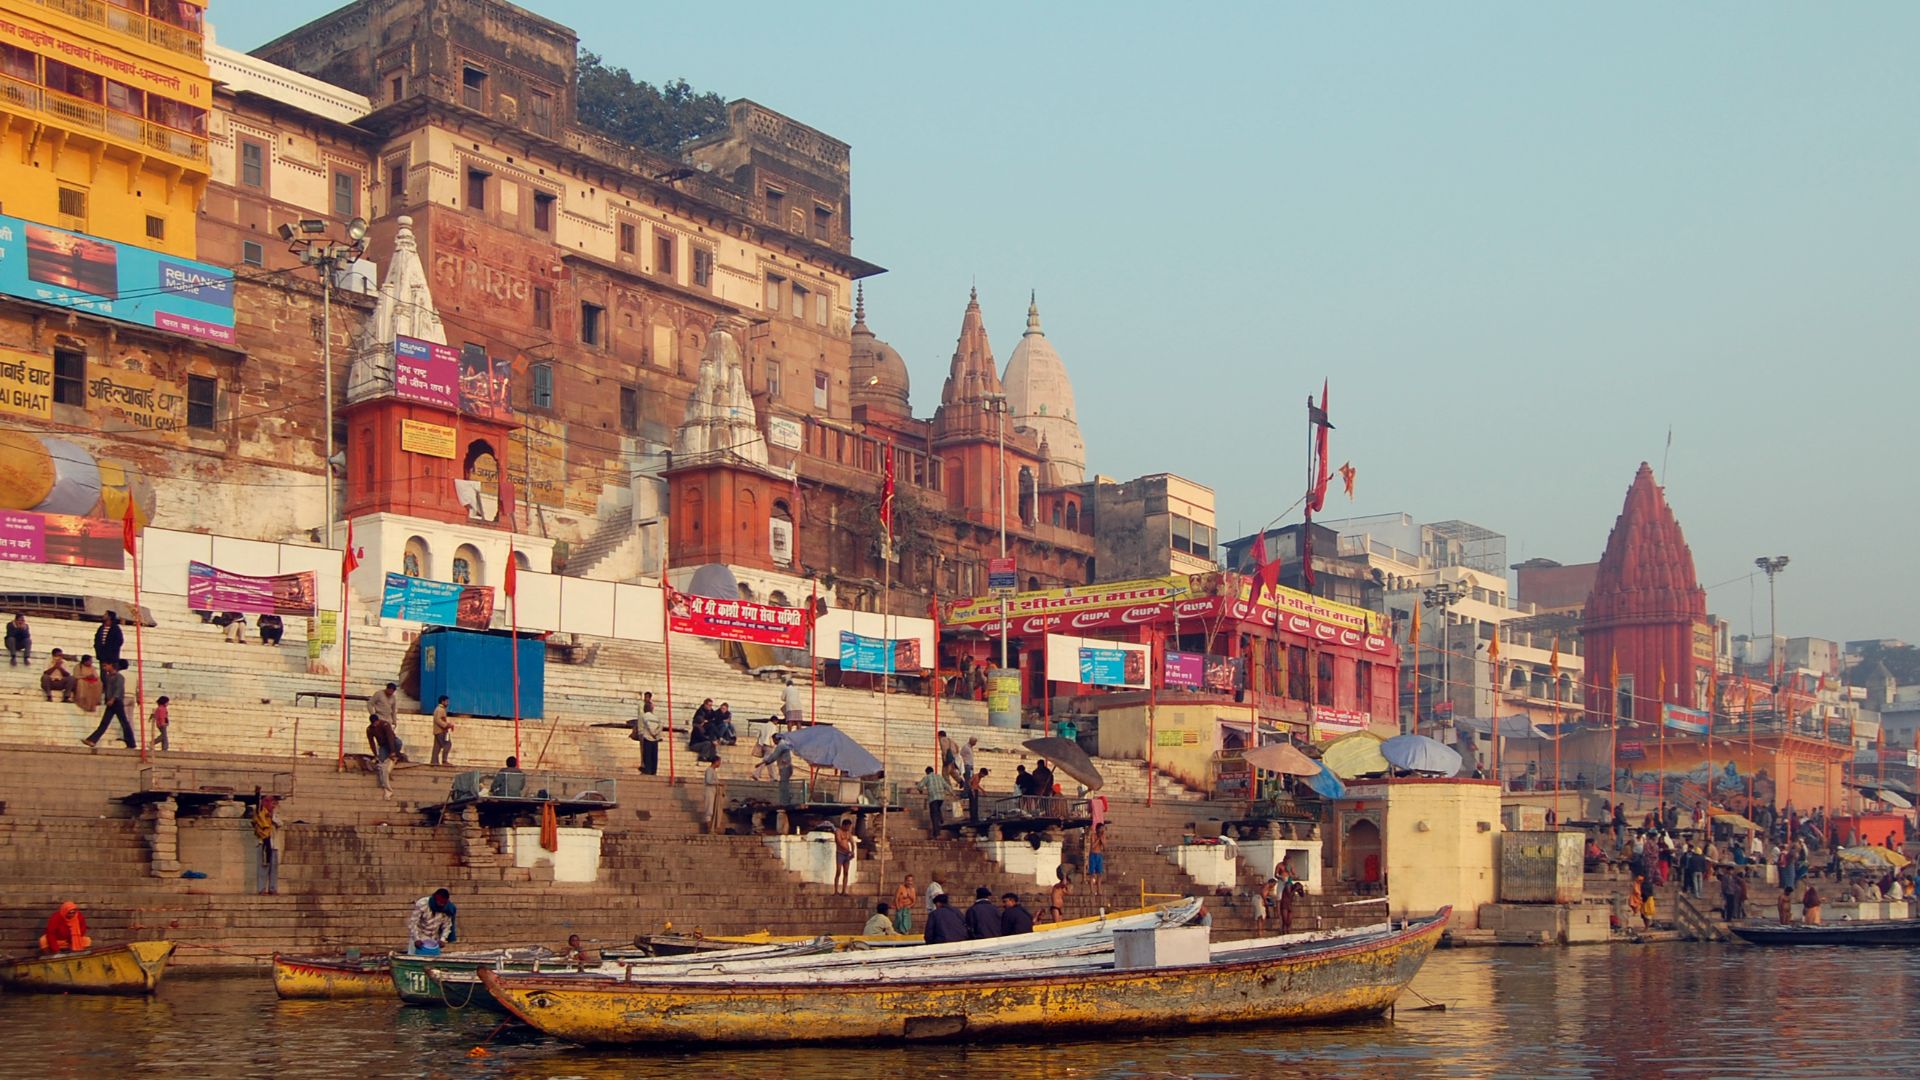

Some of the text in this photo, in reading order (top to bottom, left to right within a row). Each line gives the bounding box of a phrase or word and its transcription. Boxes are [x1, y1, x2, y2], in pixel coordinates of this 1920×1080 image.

[28, 367, 51, 386] घाट
[14, 390, 49, 411] GHAT
[692, 597, 802, 626] श्री श्री काशी गंगा सेवा समिति
[987, 621, 1013, 632] RUA
[1081, 611, 1110, 621] RUPA
[1131, 607, 1160, 617] RUPA
[1183, 601, 1213, 611] RUPA
[1239, 603, 1256, 614] RUA
[413, 974, 425, 991] 11
